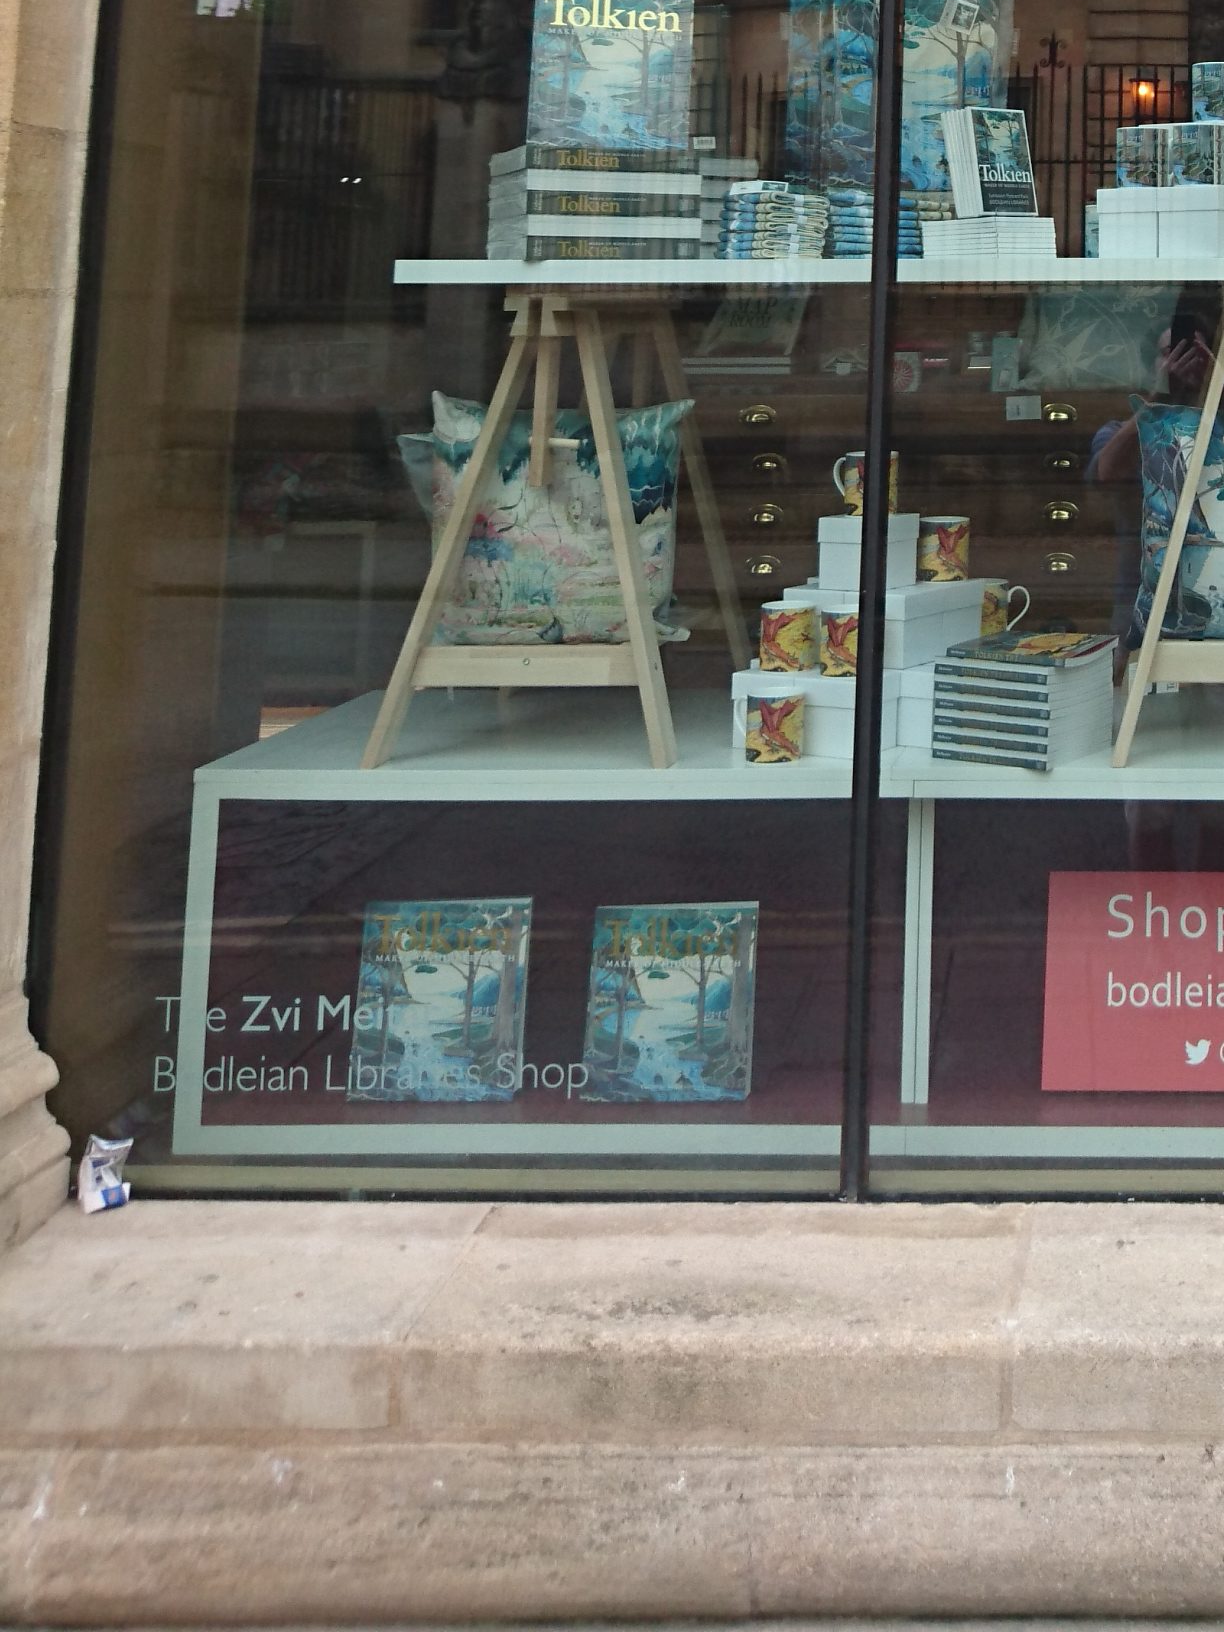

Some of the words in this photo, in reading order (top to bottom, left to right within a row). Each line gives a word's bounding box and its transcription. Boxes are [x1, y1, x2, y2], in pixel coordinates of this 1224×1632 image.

[557, 148, 620, 168] Tolkien
[979, 163, 1032, 183] Tolkien
[558, 194, 621, 213] Tolkien
[557, 240, 621, 258] Tolkien
[373, 910, 513, 955] Tolkien
[154, 995, 227, 1033] Te
[240, 994, 301, 1033] Zvi
[153, 1055, 309, 1094] Bdleian
[496, 1053, 590, 1100] Shop
